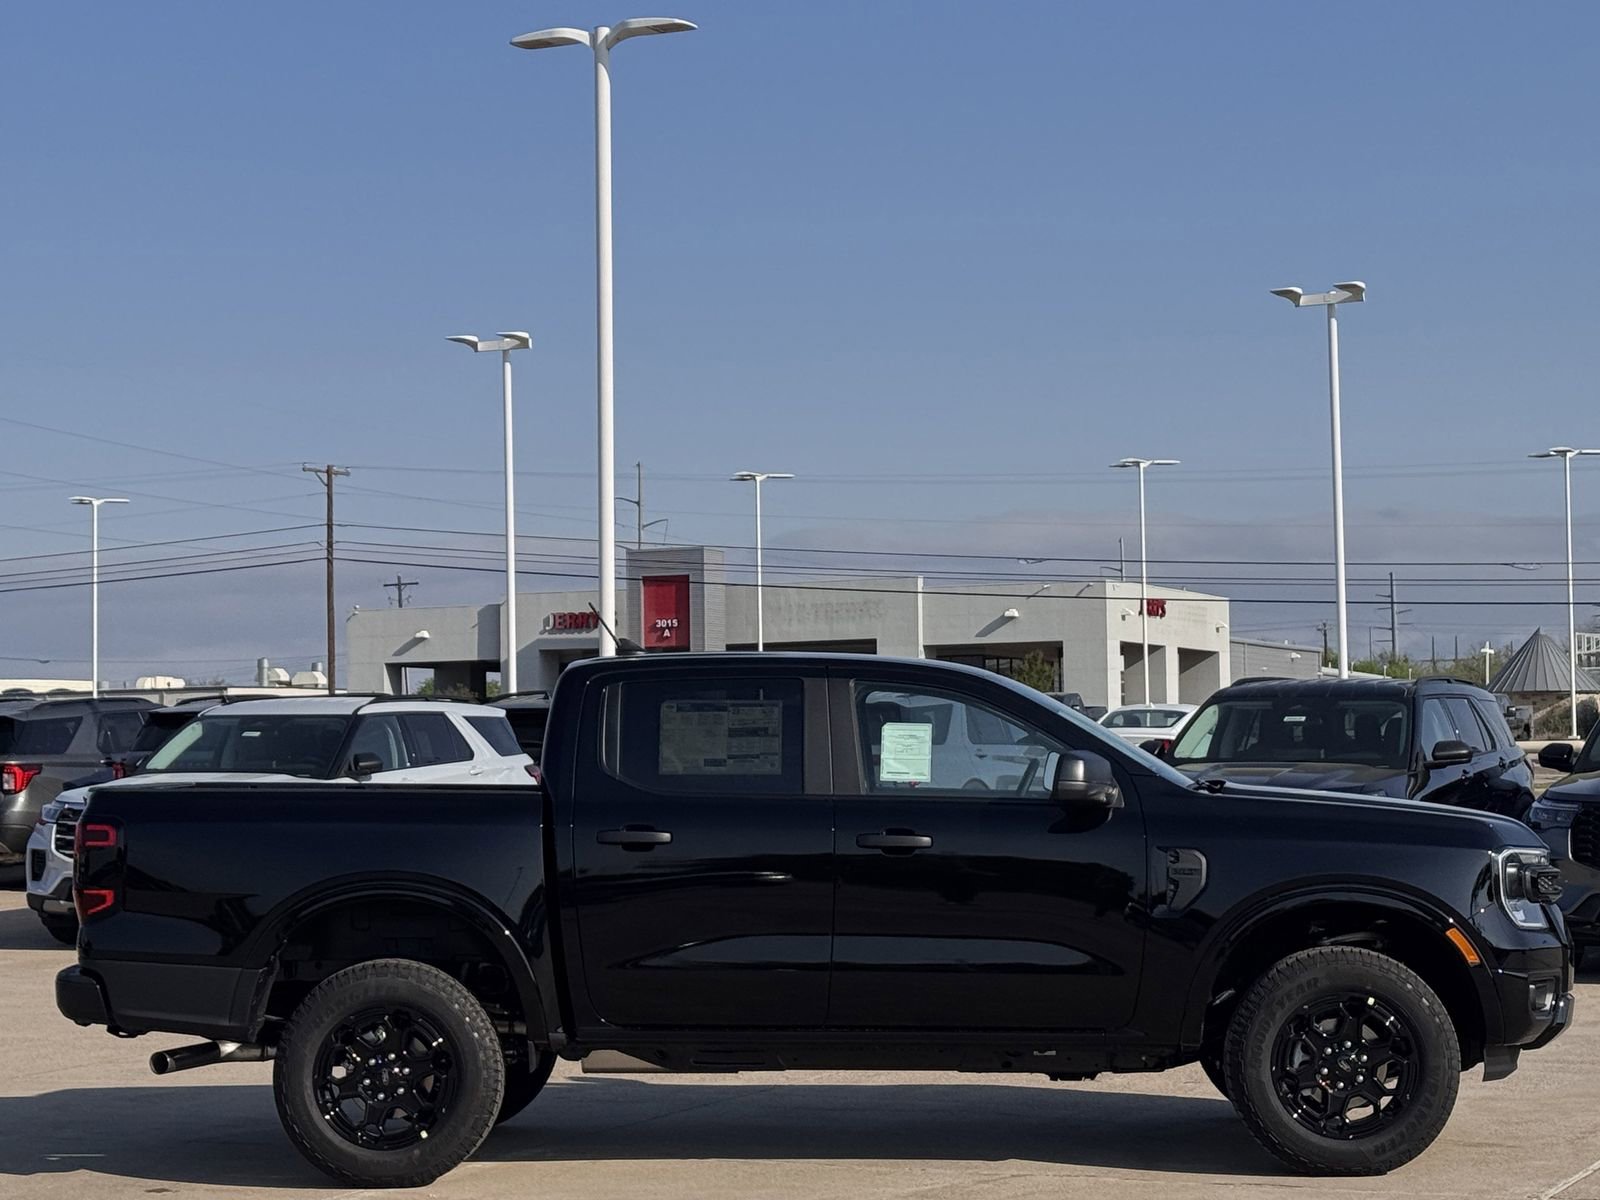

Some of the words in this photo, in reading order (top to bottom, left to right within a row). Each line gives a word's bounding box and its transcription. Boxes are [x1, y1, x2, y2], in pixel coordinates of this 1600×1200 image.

[545, 611, 617, 630] JERRY
[655, 618, 679, 628] 3015
[662, 628, 671, 638] A
